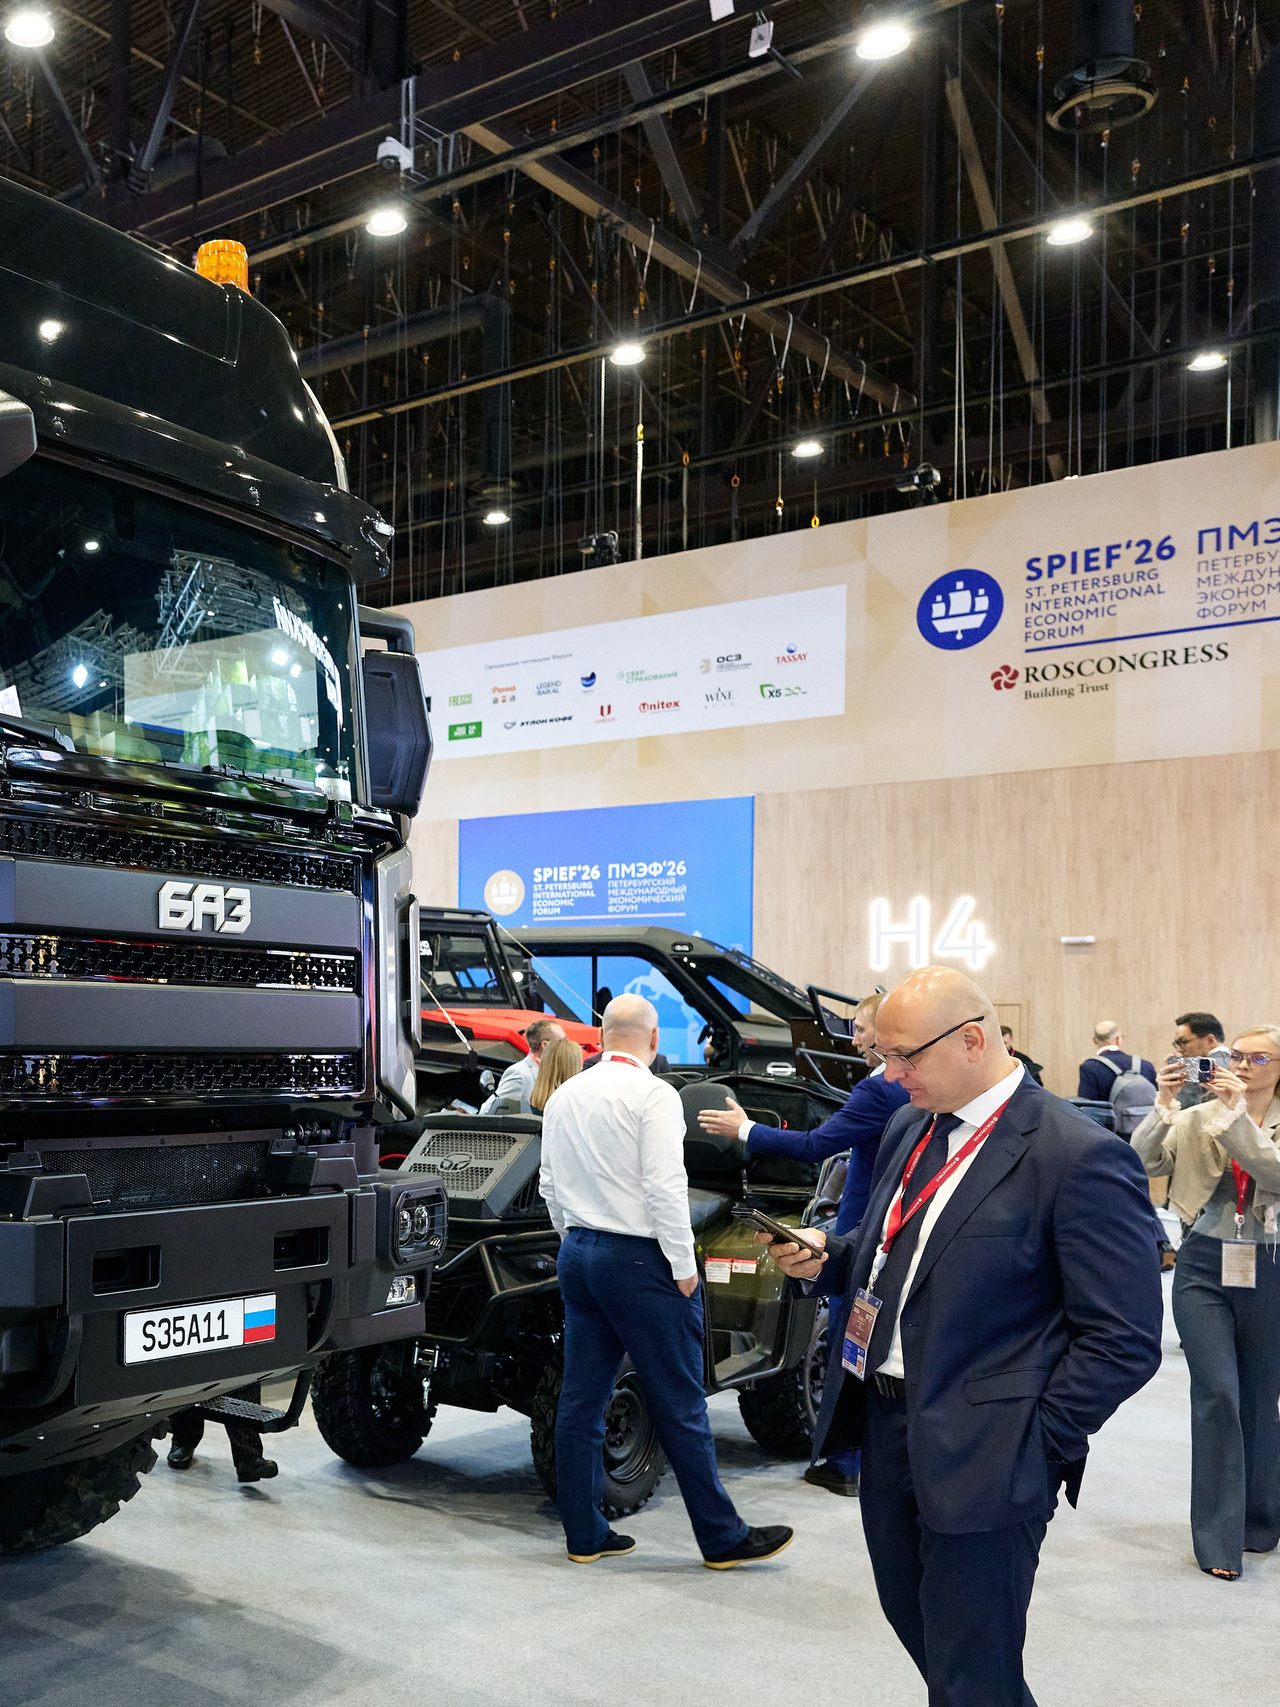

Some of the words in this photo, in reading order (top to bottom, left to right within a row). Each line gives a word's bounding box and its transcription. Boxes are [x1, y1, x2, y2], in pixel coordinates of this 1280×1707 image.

[1025, 535, 1177, 582] SPIEF'26
[1197, 549, 1280, 573] ПЕТЕРБУ
[1025, 586, 1047, 599] ST.
[1051, 568, 1159, 596] PETERSBURG
[1025, 583, 1166, 613] INTERNATIONAL
[1025, 604, 1118, 628] ECONOMIC
[1197, 599, 1266, 619] ФОРУМ
[1025, 624, 1085, 642] FORUM
[776, 653, 808, 665] TASSAY
[1024, 642, 1229, 684] ROSCONGRESS
[1024, 685, 1075, 700] Building
[1079, 682, 1110, 695] Trust
[533, 864, 601, 883] SPIEF'26
[607, 860, 687, 879] ПМЭФ'26
[545, 881, 593, 891] PETERSBURG
[607, 877, 676, 888] ПЕТЕРБУРГСКИЙ
[607, 885, 687, 897] МЕЖДУНАРОДНЫЙ
[533, 889, 596, 899] INTERNATIONAL
[533, 898, 575, 908] ECONOMIC
[607, 894, 685, 905] ЭКОНОМИЧЕСКИЙ
[533, 907, 561, 916] FORUM
[607, 904, 639, 914] ФОРУМ
[871, 897, 993, 969] H4
[142, 1309, 229, 1352] S35A11
